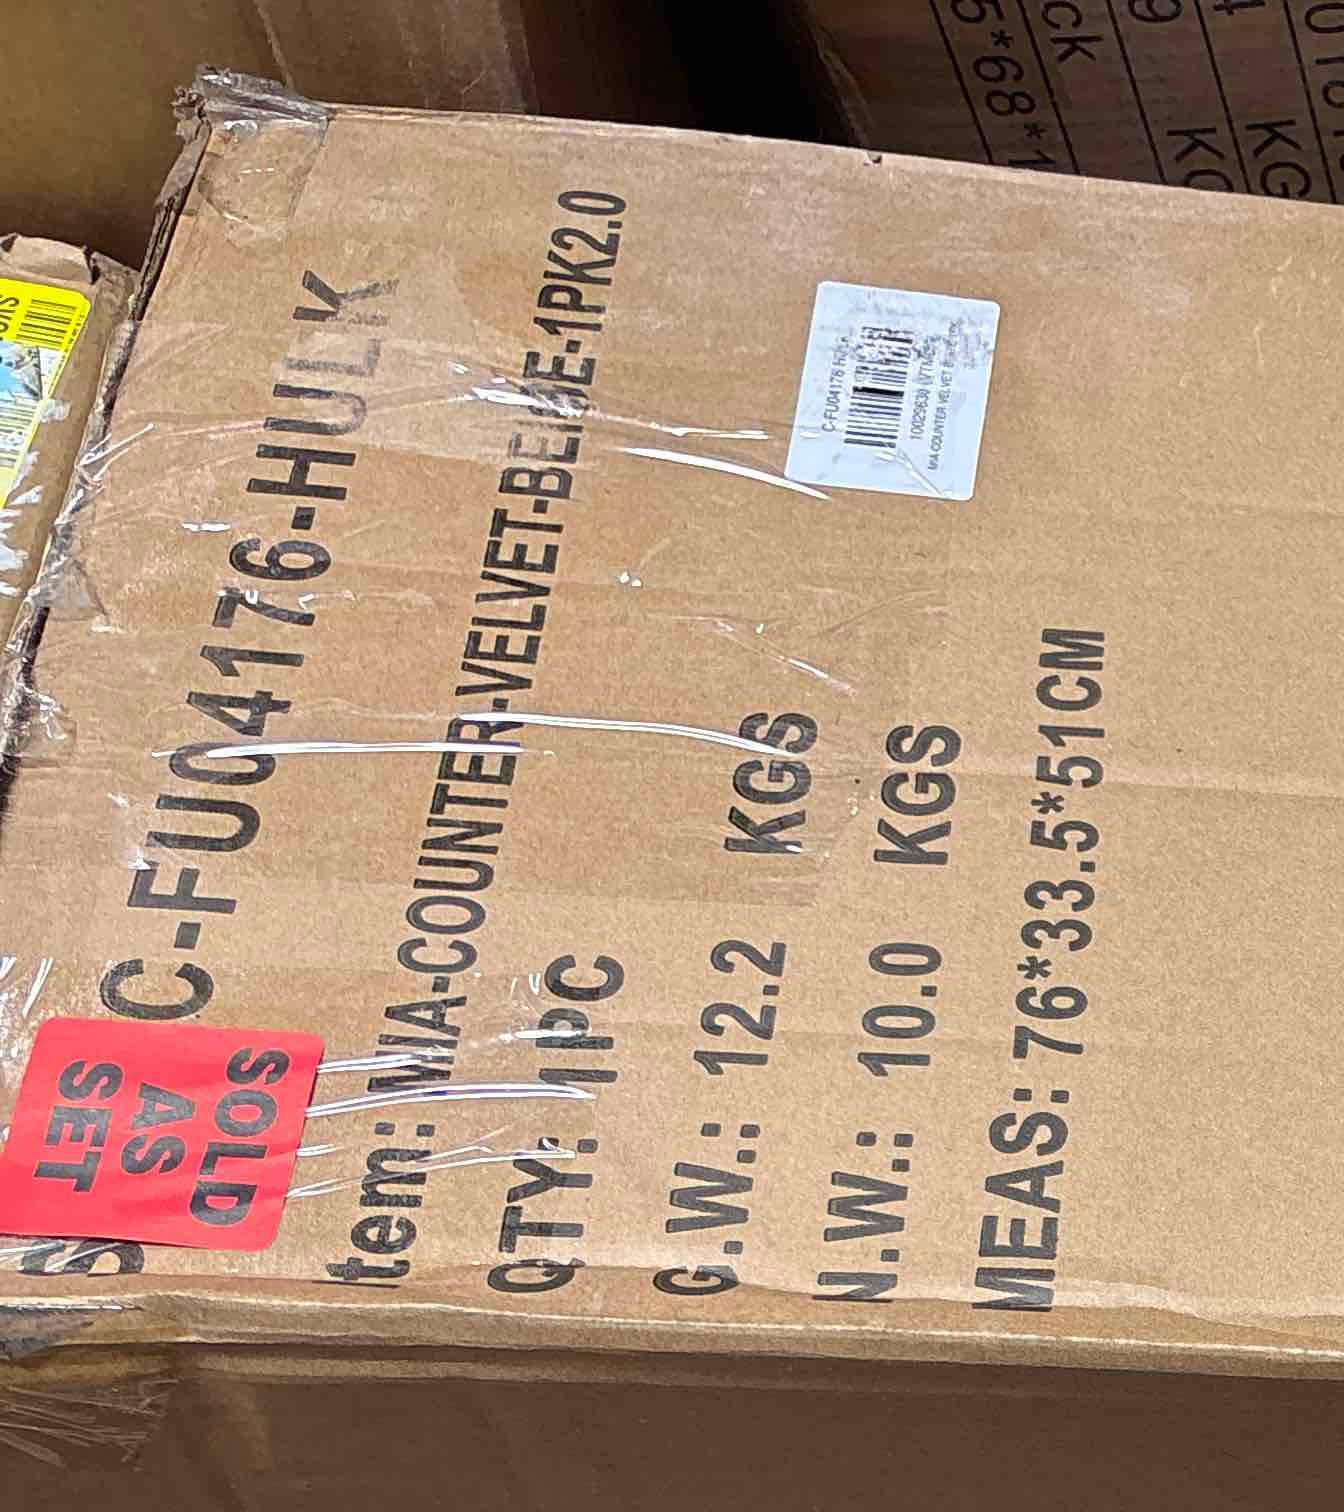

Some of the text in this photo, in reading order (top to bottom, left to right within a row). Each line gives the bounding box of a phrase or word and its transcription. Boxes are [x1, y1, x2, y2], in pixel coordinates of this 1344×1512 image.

[653, 711, 818, 1297] G.W.: 12.2 KGS
[812, 723, 962, 1303] N.W.: 10.0 KGS
[33, 1060, 124, 1193] SET
[120, 1082, 196, 1176] AS
[189, 1047, 291, 1227] SOLD
[313, 1120, 436, 1286] tem:
[972, 1086, 1071, 1312] MEAS:
